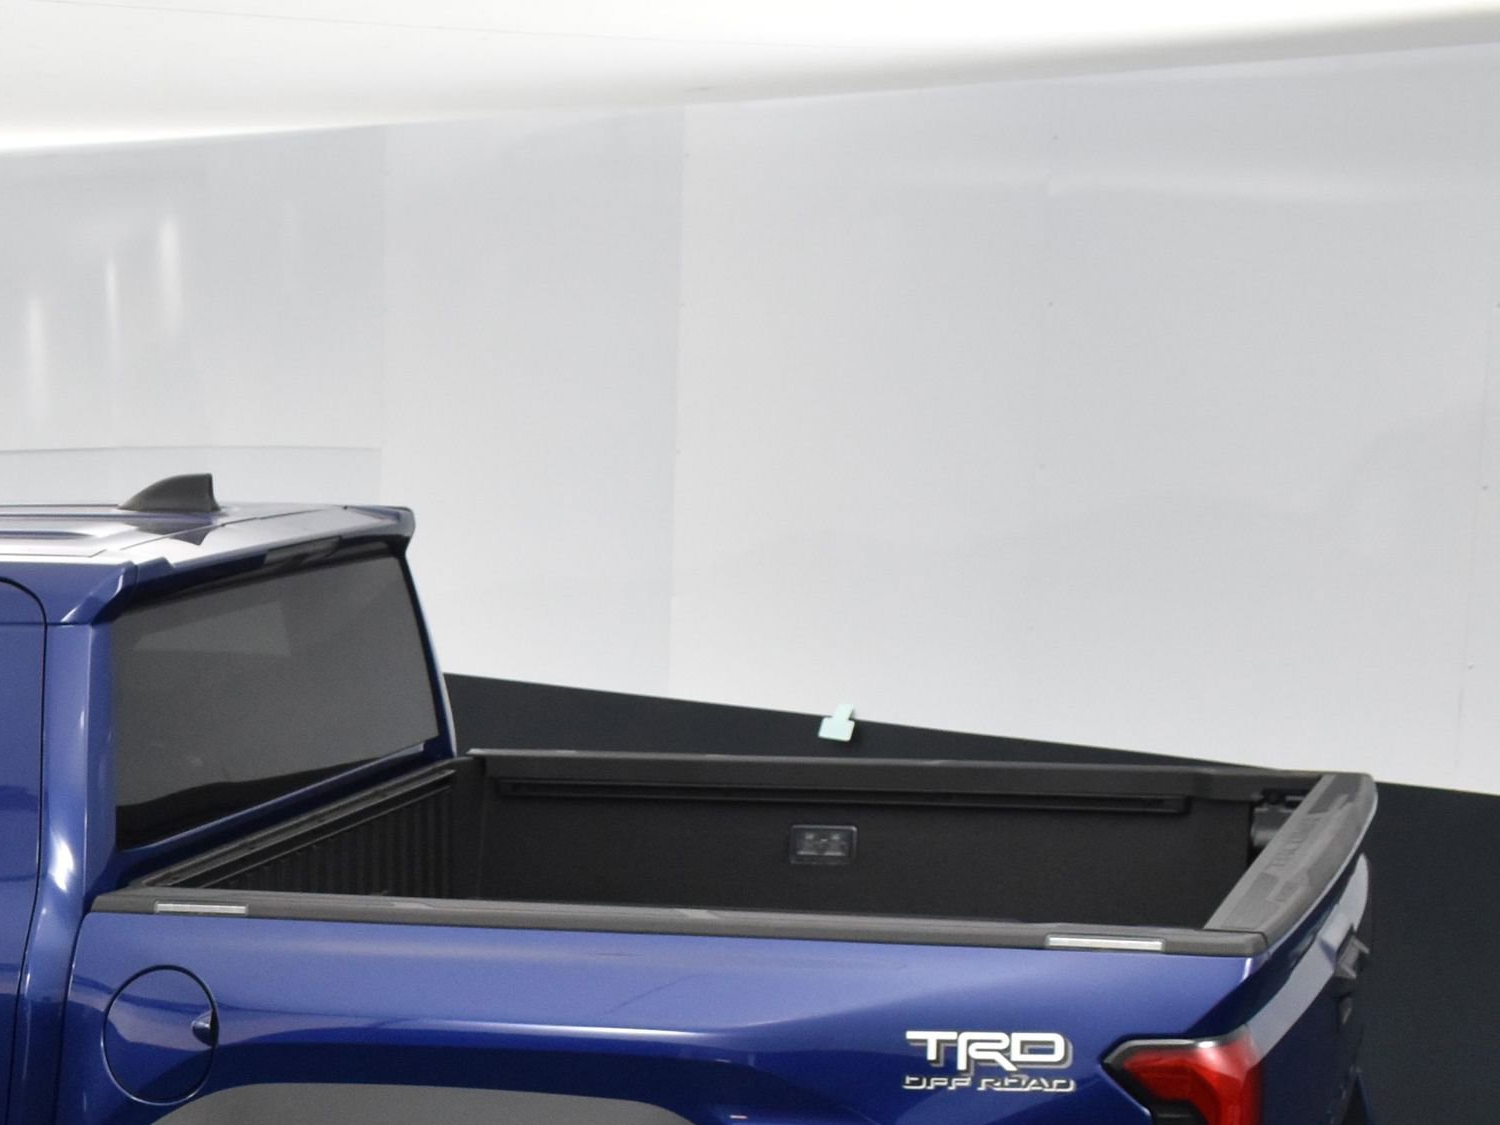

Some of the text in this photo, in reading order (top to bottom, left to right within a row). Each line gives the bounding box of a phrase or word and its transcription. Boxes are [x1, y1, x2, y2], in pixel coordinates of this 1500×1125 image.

[905, 1030, 1070, 1074] TRD
[902, 1075, 1076, 1093] OFF ROAD
